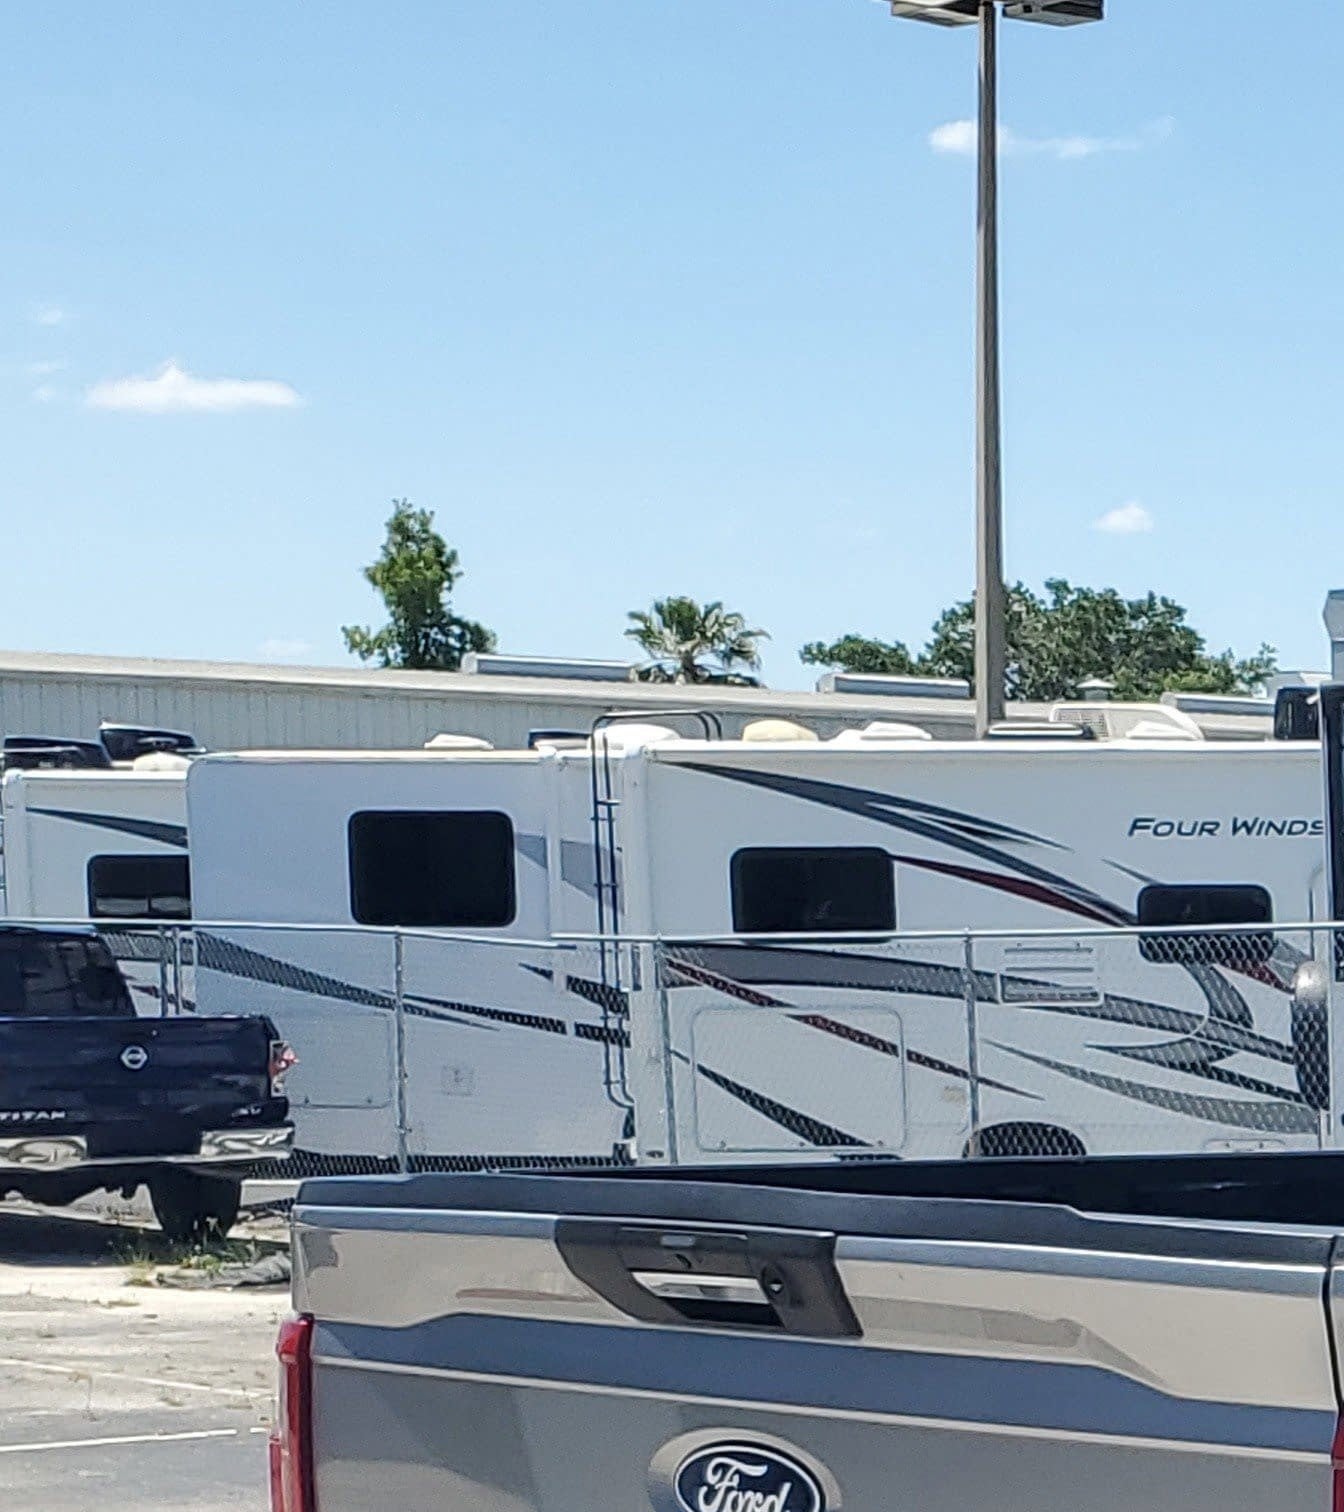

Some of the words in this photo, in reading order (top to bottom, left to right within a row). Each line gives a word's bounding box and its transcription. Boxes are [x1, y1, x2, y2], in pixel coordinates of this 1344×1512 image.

[1128, 817, 1221, 837] FOUR
[1231, 816, 1325, 837] WINDS
[0, 1110, 66, 1121] TITAN
